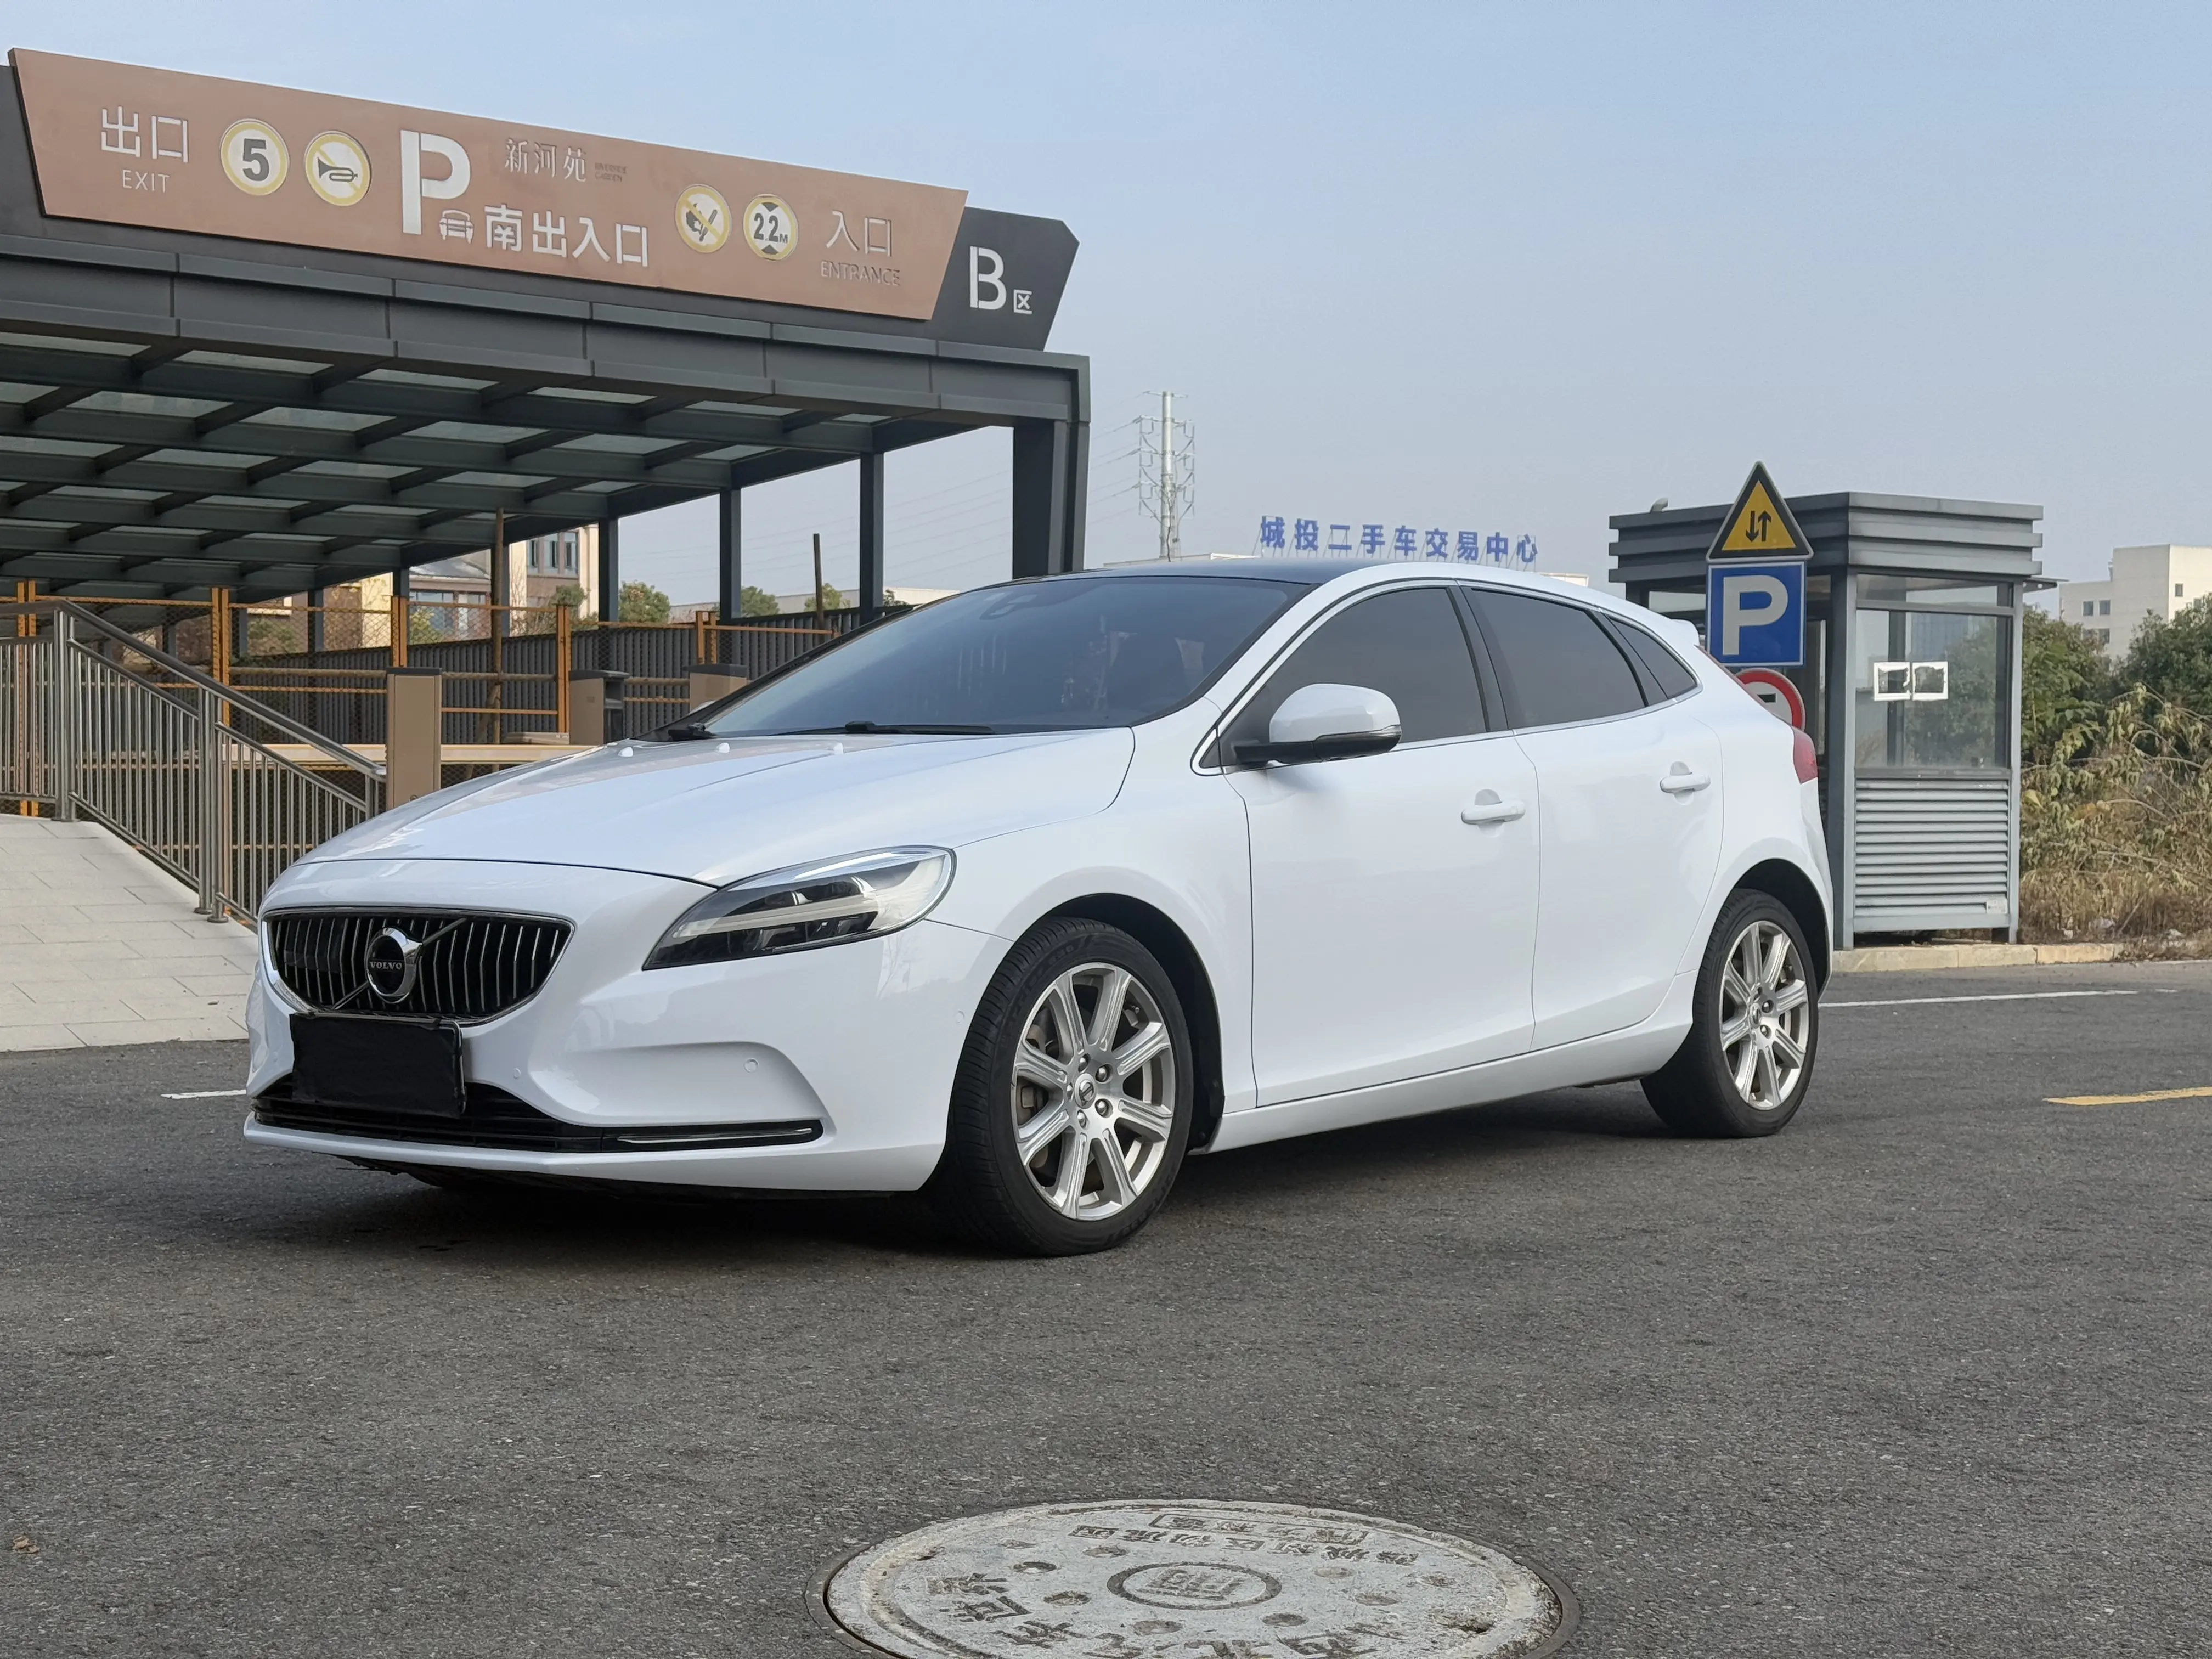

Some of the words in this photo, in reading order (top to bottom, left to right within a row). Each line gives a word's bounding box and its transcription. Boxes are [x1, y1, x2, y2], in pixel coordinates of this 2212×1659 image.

[101, 106, 189, 163] 出口
[122, 169, 170, 193] EXIT
[242, 138, 270, 182] 5
[400, 129, 472, 235] P
[505, 137, 587, 182] 新河苑
[484, 203, 648, 267] 南出入口
[826, 210, 893, 257] 入口
[821, 261, 901, 286] ENTRANCE
[1261, 516, 1538, 563] 城投二手车交易中心
[1722, 574, 1788, 656] P
[369, 961, 403, 970] VOLVO
